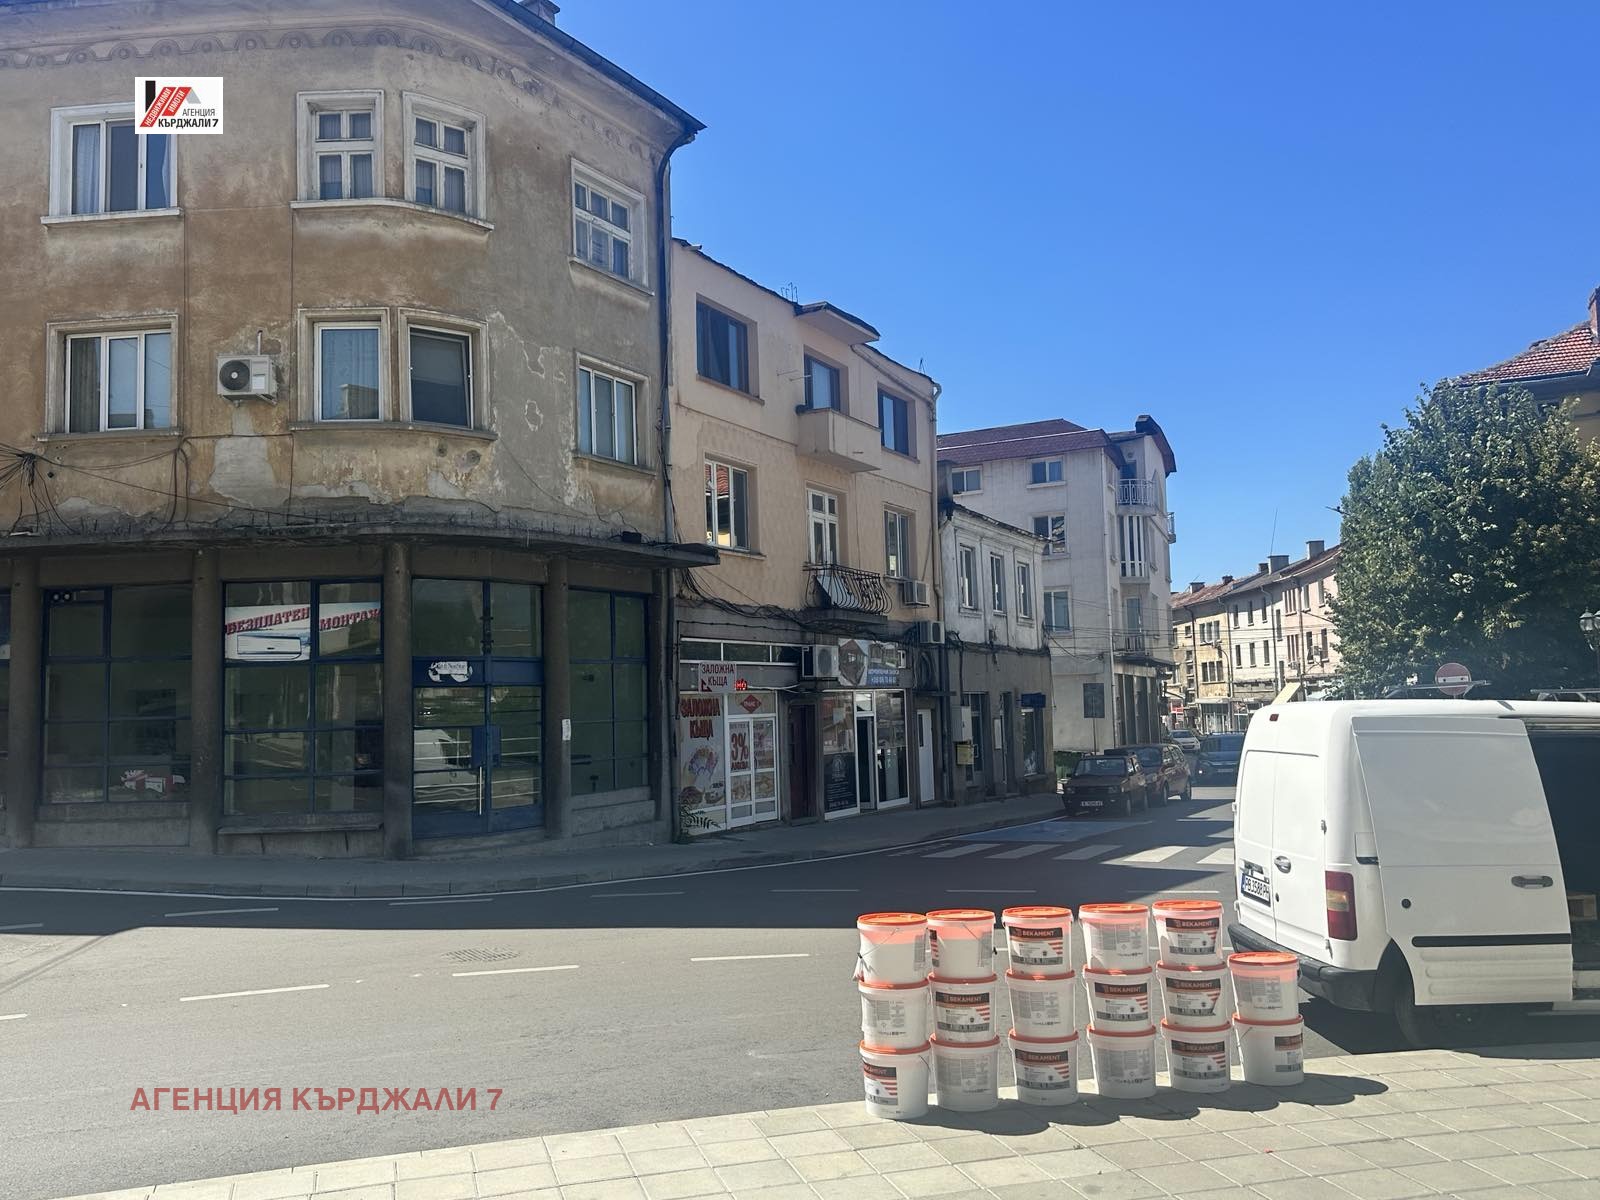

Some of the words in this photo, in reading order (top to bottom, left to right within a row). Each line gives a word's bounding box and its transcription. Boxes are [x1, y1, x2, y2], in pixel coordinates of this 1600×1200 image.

[225, 606, 310, 636] БЕЗПЛАТЕН
[702, 663, 735, 674] ЗАЛОЖНА
[681, 697, 721, 718] ЗАЛОЖНА
[731, 732, 749, 761] 3%
[1022, 929, 1055, 937] BEKAMENT
